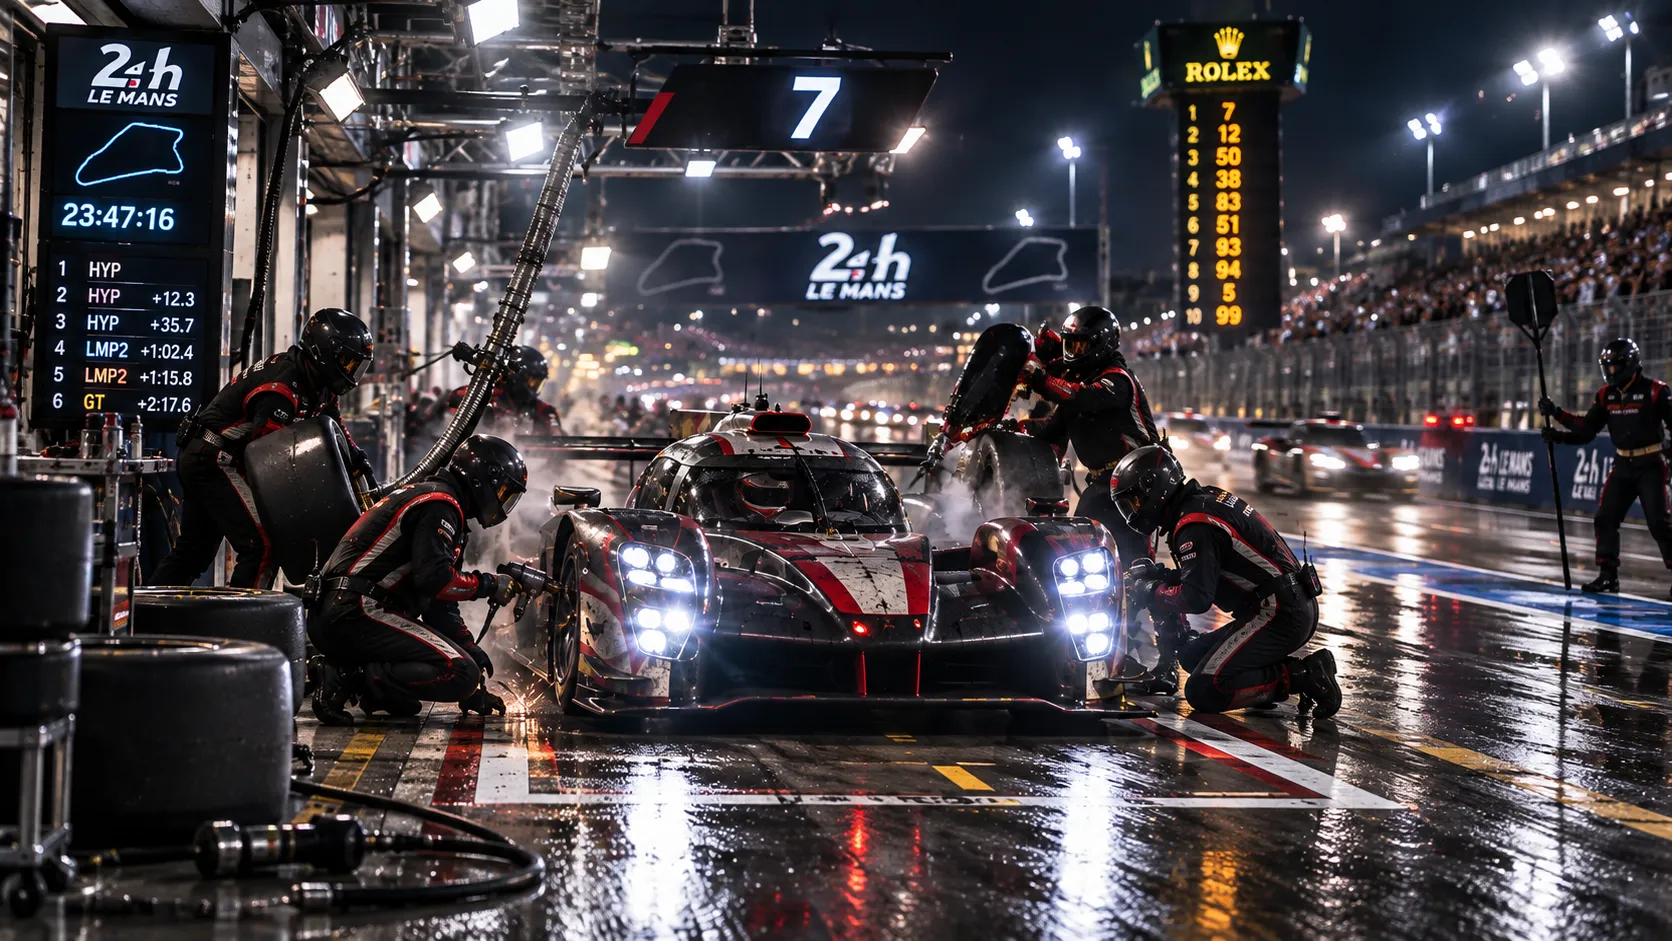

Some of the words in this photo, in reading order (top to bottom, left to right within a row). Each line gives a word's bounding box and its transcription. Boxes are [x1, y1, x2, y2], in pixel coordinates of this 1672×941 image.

[1186, 61, 1270, 82] ROLEX
[87, 89, 113, 103] LE
[117, 91, 178, 107] MANS
[791, 76, 841, 139] 7
[1189, 105, 1196, 120] 1
[1222, 102, 1235, 121] 7
[1188, 126, 1199, 143] 2
[1218, 124, 1241, 143] 12
[1188, 149, 1198, 166] 3
[1216, 146, 1241, 166] 50
[1188, 172, 1199, 187] 4
[1216, 169, 1241, 189] 38
[1188, 194, 1199, 211] 5
[1216, 192, 1241, 211] 83
[62, 203, 174, 230] 23:47:16
[1188, 217, 1199, 234] 6
[1216, 214, 1239, 234] 51
[1188, 239, 1199, 256] 7
[1216, 237, 1241, 257] 93
[59, 260, 65, 276] 1
[90, 261, 121, 278] HYP
[1188, 262, 1199, 279] 8
[1216, 260, 1241, 280] 94
[57, 287, 67, 302] 2
[89, 288, 120, 303] HYP
[152, 292, 194, 307] +12.3
[806, 282, 835, 300] LE
[839, 282, 907, 300] MANS
[1188, 285, 1199, 302] 9
[1222, 282, 1236, 302] 5
[56, 313, 65, 329] 3
[87, 315, 119, 331] HYP
[151, 317, 194, 333] +35.7
[1186, 308, 1202, 325] 10
[1216, 305, 1242, 325] 99
[55, 340, 65, 355] 4
[86, 341, 128, 358] LMP2
[141, 344, 193, 359] +1:02.4
[54, 367, 63, 382] 5
[85, 368, 127, 384] LMP2
[140, 370, 192, 385] +1:15.8
[53, 393, 62, 408] 6
[83, 394, 105, 410] GT
[137, 397, 191, 413] +2:17.6
